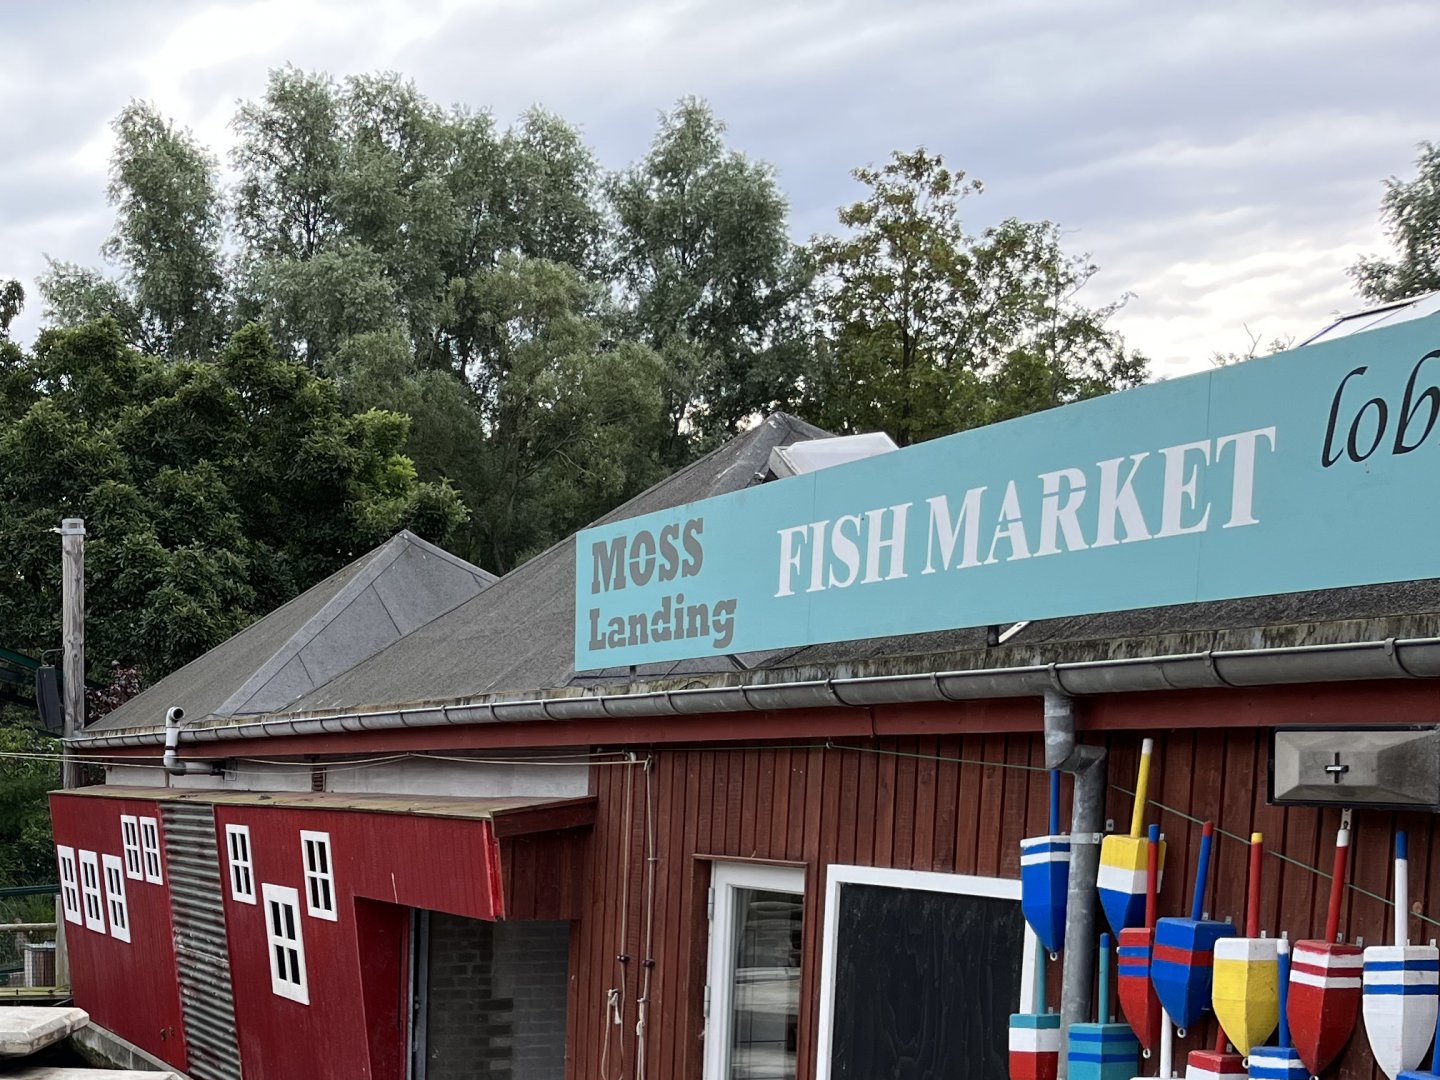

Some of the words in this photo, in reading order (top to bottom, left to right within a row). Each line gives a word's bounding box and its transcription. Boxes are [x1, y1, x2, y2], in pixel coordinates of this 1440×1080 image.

[774, 503, 912, 597] FISH
[921, 426, 1276, 574] MARKET
[591, 518, 704, 594] MOSS
[589, 593, 737, 650] Landing
